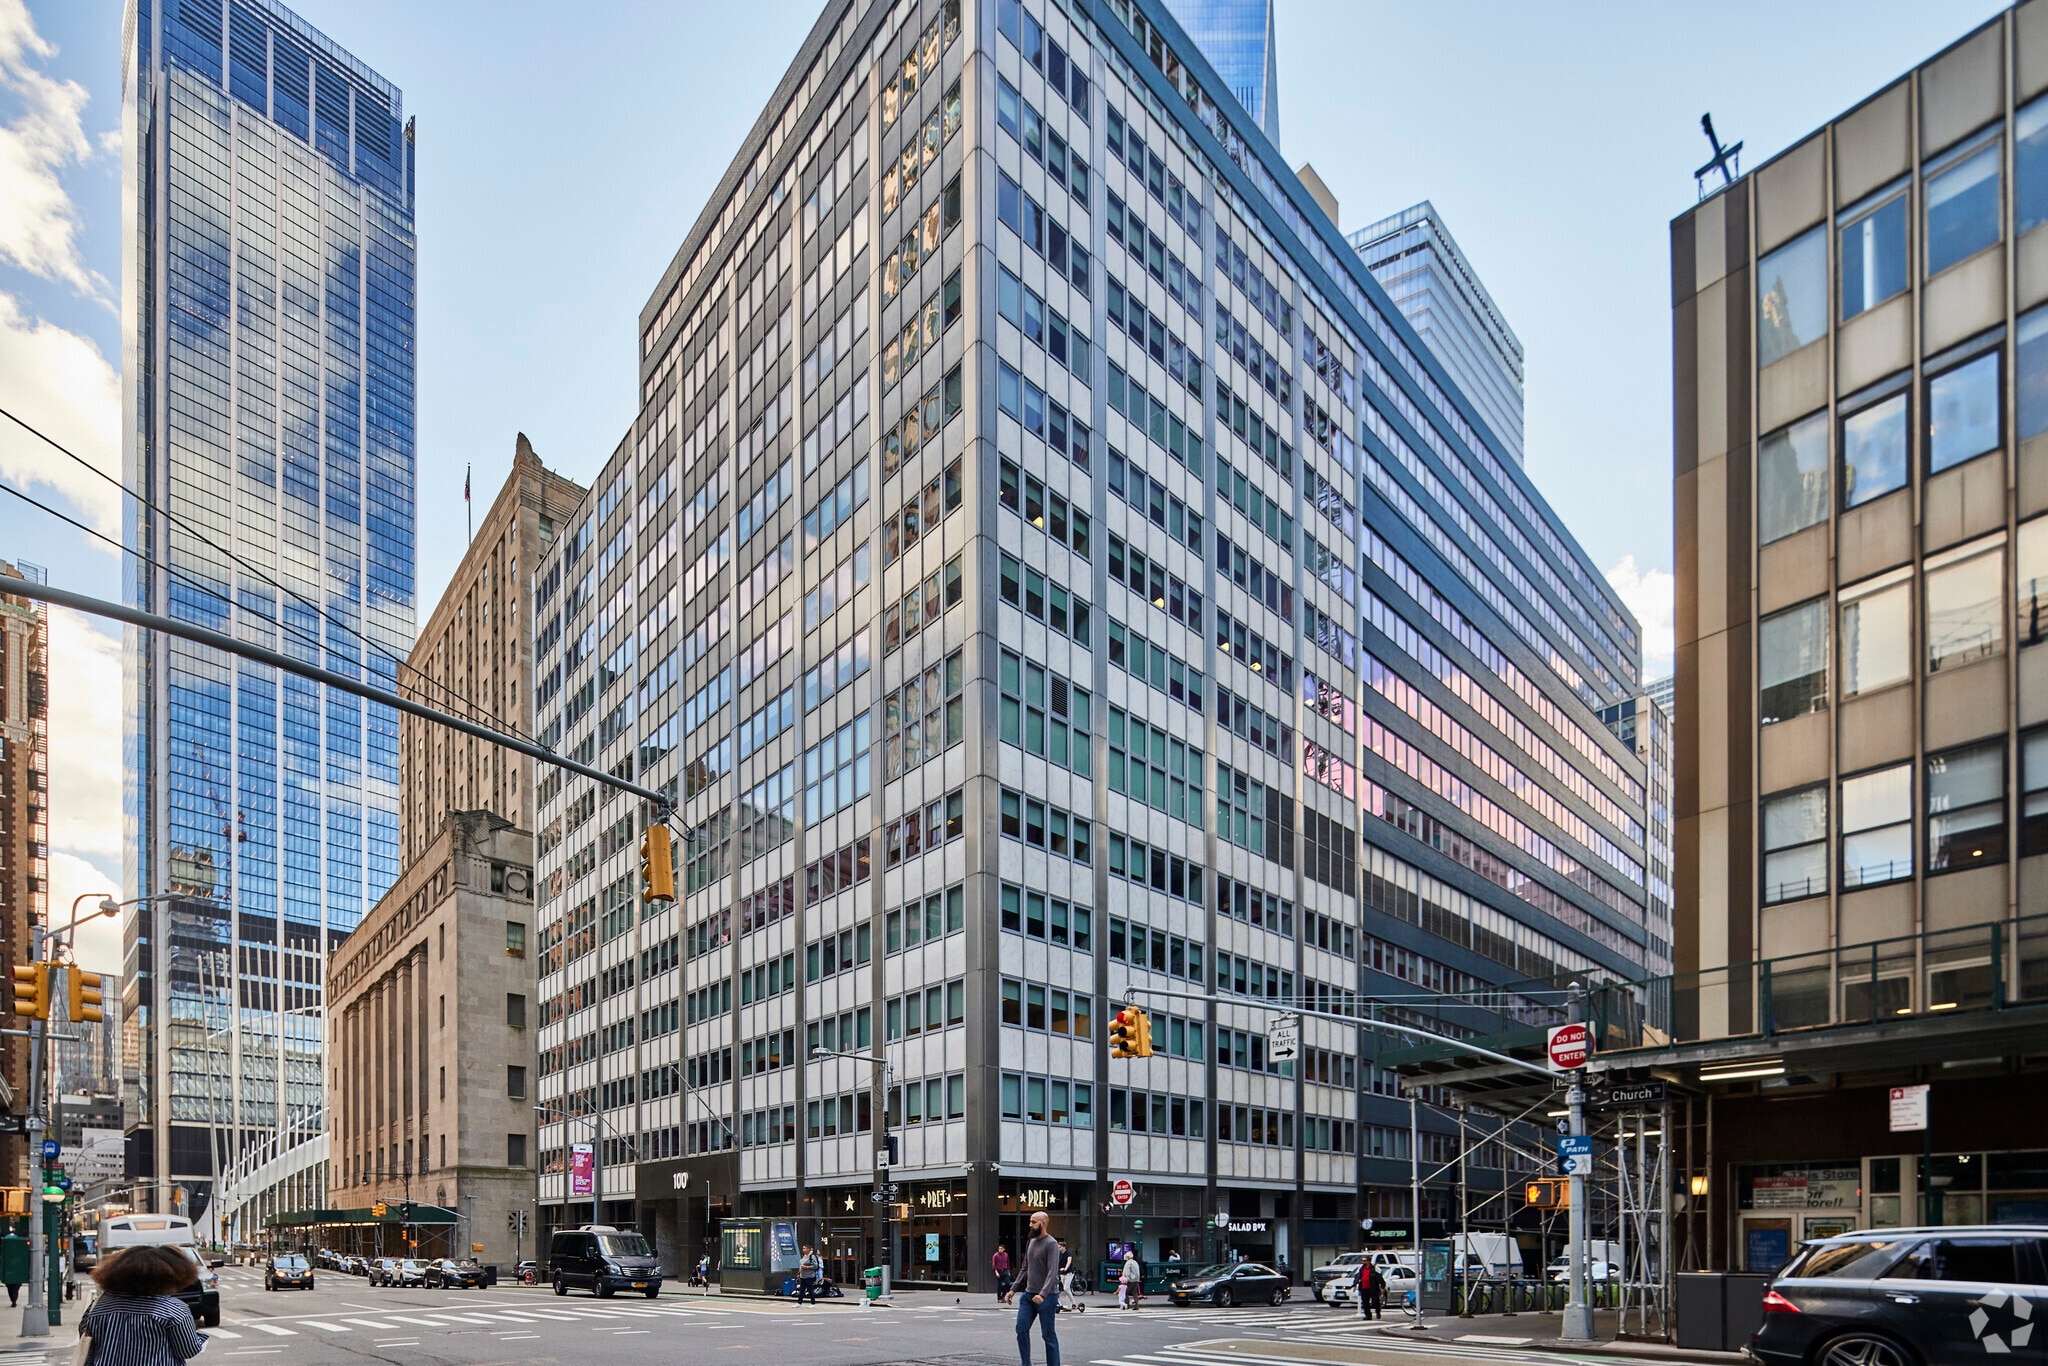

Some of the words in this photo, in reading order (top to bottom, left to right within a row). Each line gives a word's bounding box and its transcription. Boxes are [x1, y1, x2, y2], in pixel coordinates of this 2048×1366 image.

[1277, 1030, 1291, 1038] ALL
[1556, 1034, 1568, 1043] DO
[1570, 1032, 1586, 1041] NOT
[1272, 1038, 1296, 1048] TRAFFIC
[1559, 1051, 1586, 1061] ENTER
[1612, 1088, 1652, 1101] Church
[1822, 1169, 1859, 1180] Store
[673, 1172, 688, 1190] 100
[927, 1189, 947, 1208] PRET
[1027, 1189, 1050, 1208] PRET
[1228, 1222, 1252, 1232] SALAD
